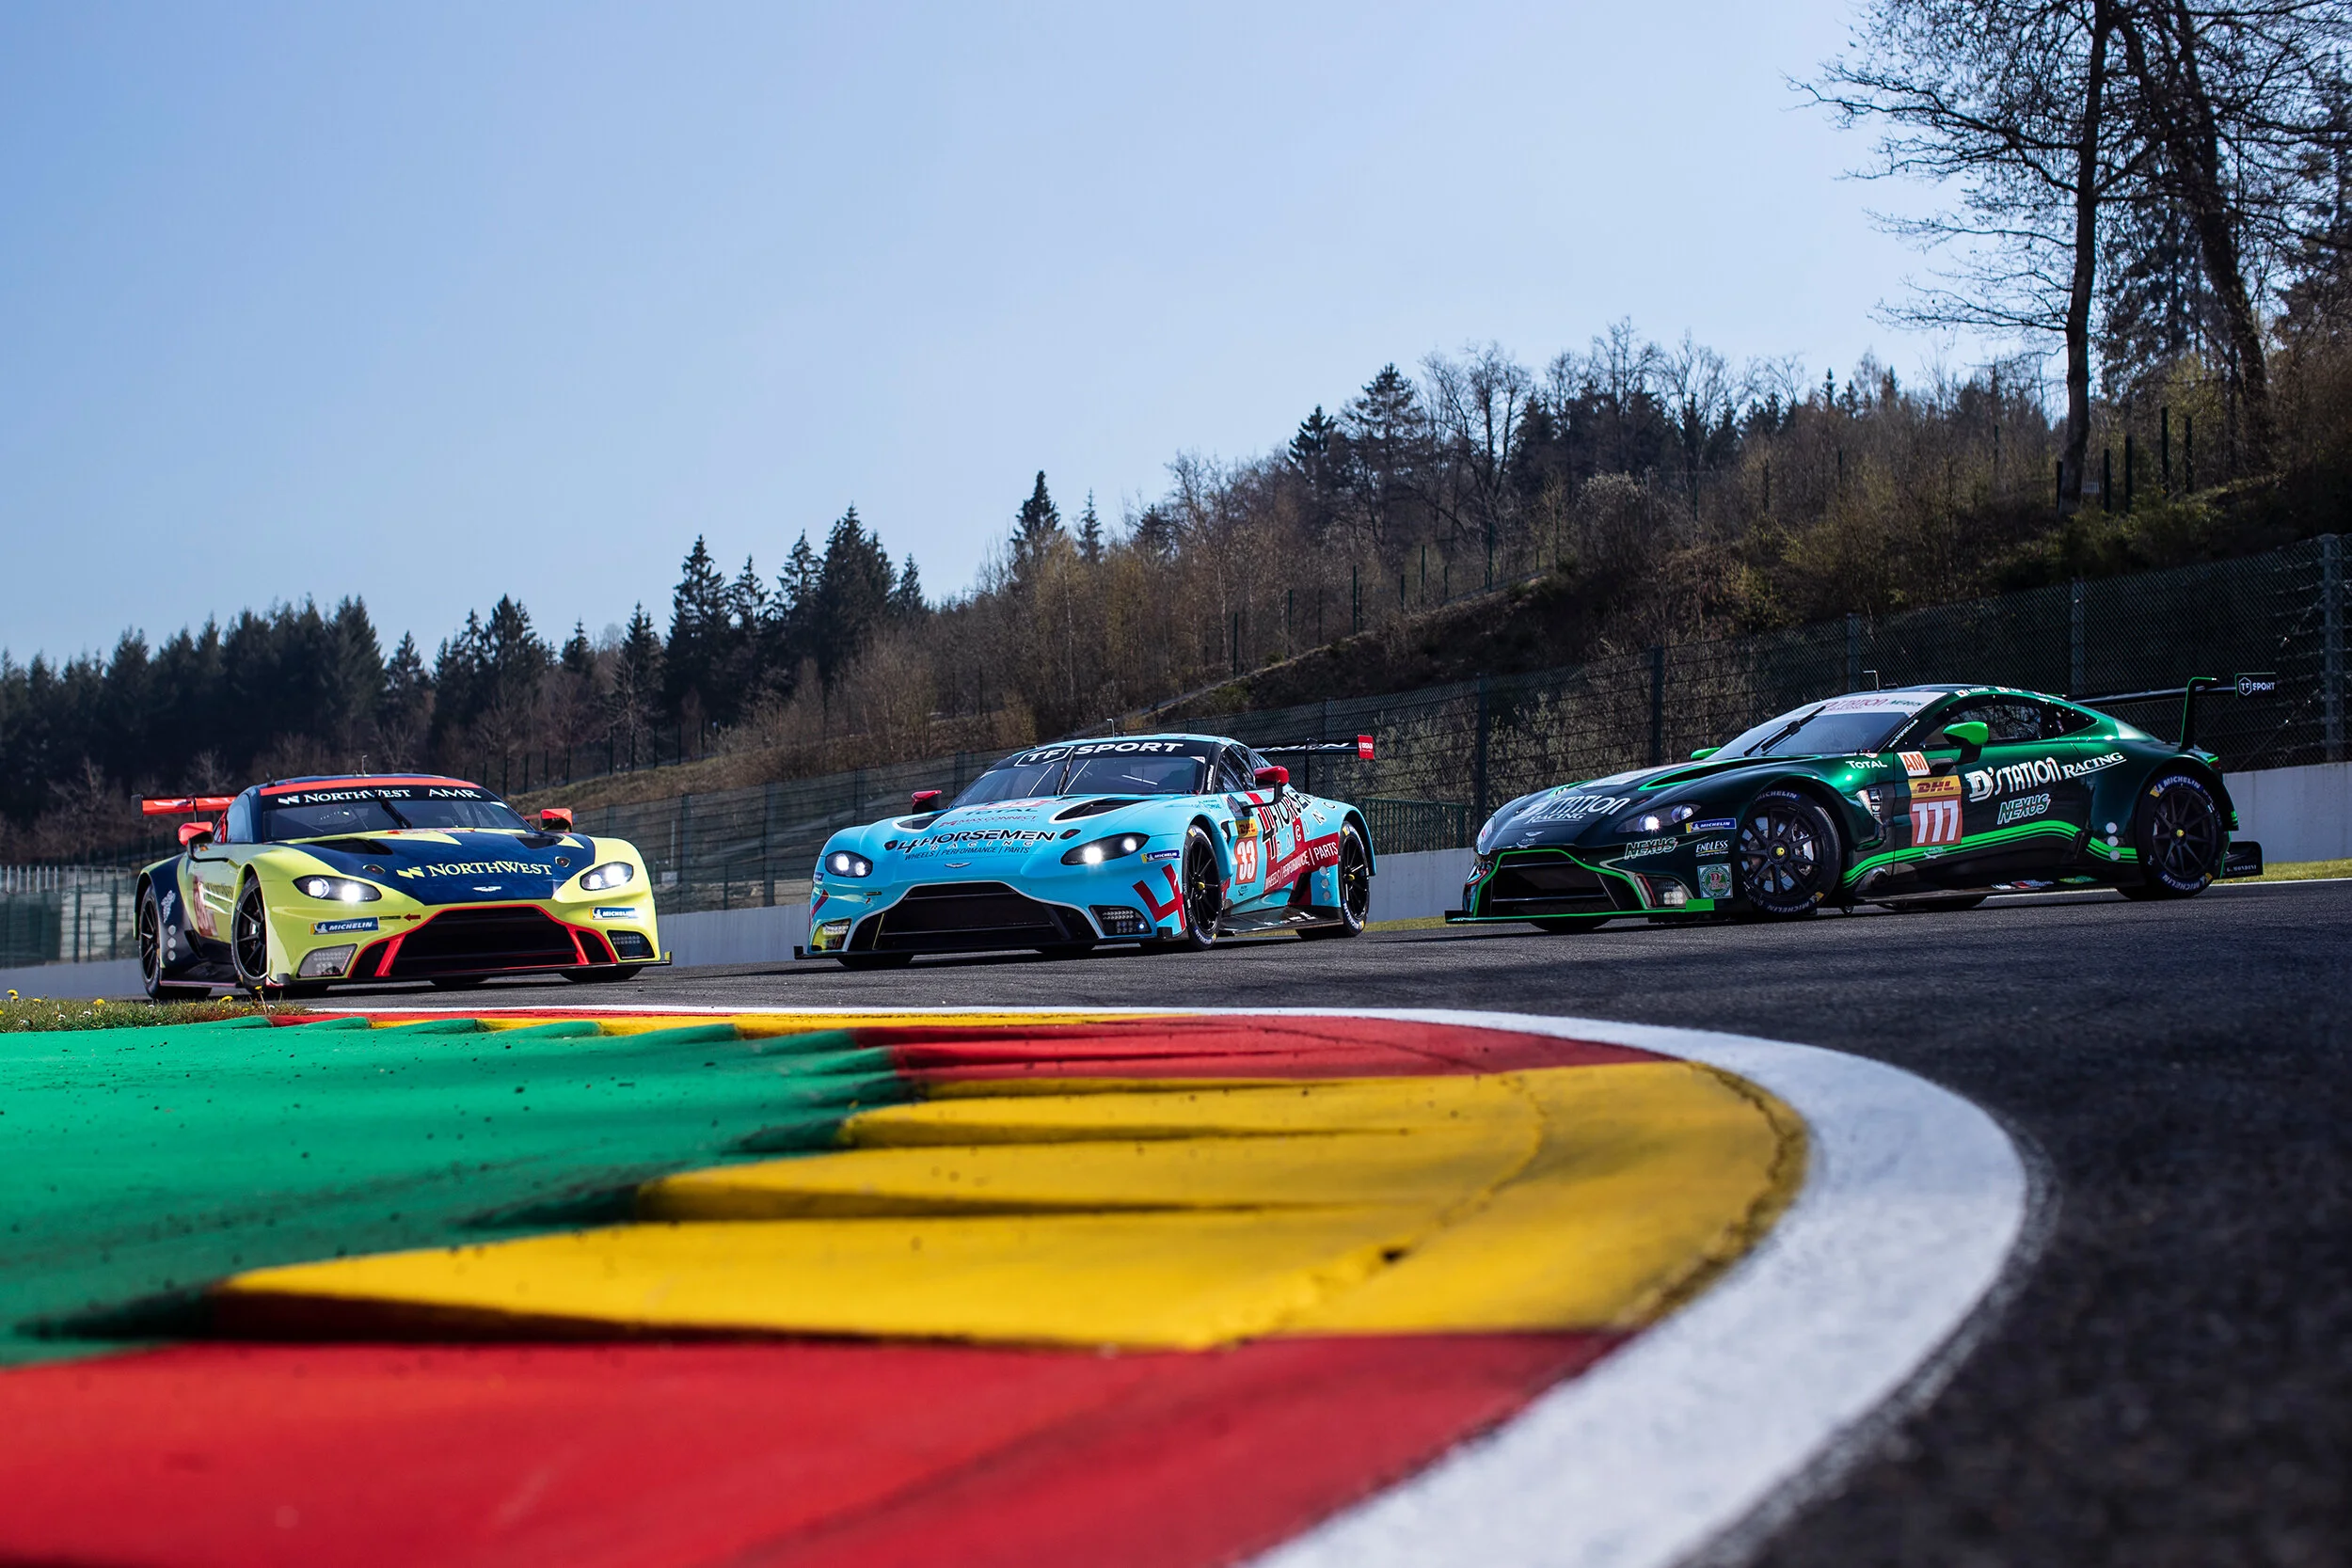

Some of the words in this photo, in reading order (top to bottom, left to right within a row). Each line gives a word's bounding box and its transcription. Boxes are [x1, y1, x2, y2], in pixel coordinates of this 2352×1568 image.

[2252, 682, 2275, 690] SPORT
[1028, 748, 1065, 762] TF
[1073, 742, 1184, 755] SPORT
[1846, 761, 1888, 769] TOTAL
[1902, 753, 1928, 771] AM
[2060, 752, 2126, 780] RACING
[1916, 780, 1955, 793] DHL
[2163, 775, 2201, 789] MICHELIN
[428, 788, 482, 800] AMR
[1997, 793, 2051, 825] NEXUS
[1912, 800, 1959, 844] 777
[930, 840, 1033, 851] RACING
[1313, 841, 1338, 861] PARTS
[1624, 836, 1678, 861] NEXUS
[1695, 839, 1729, 853] ENDLESS
[905, 849, 934, 861] WHEELS
[942, 847, 996, 856] PERFORMANCE
[1236, 840, 1256, 881] 33
[426, 860, 553, 878] NORTHWEST
[328, 922, 373, 931] MICHELIN
